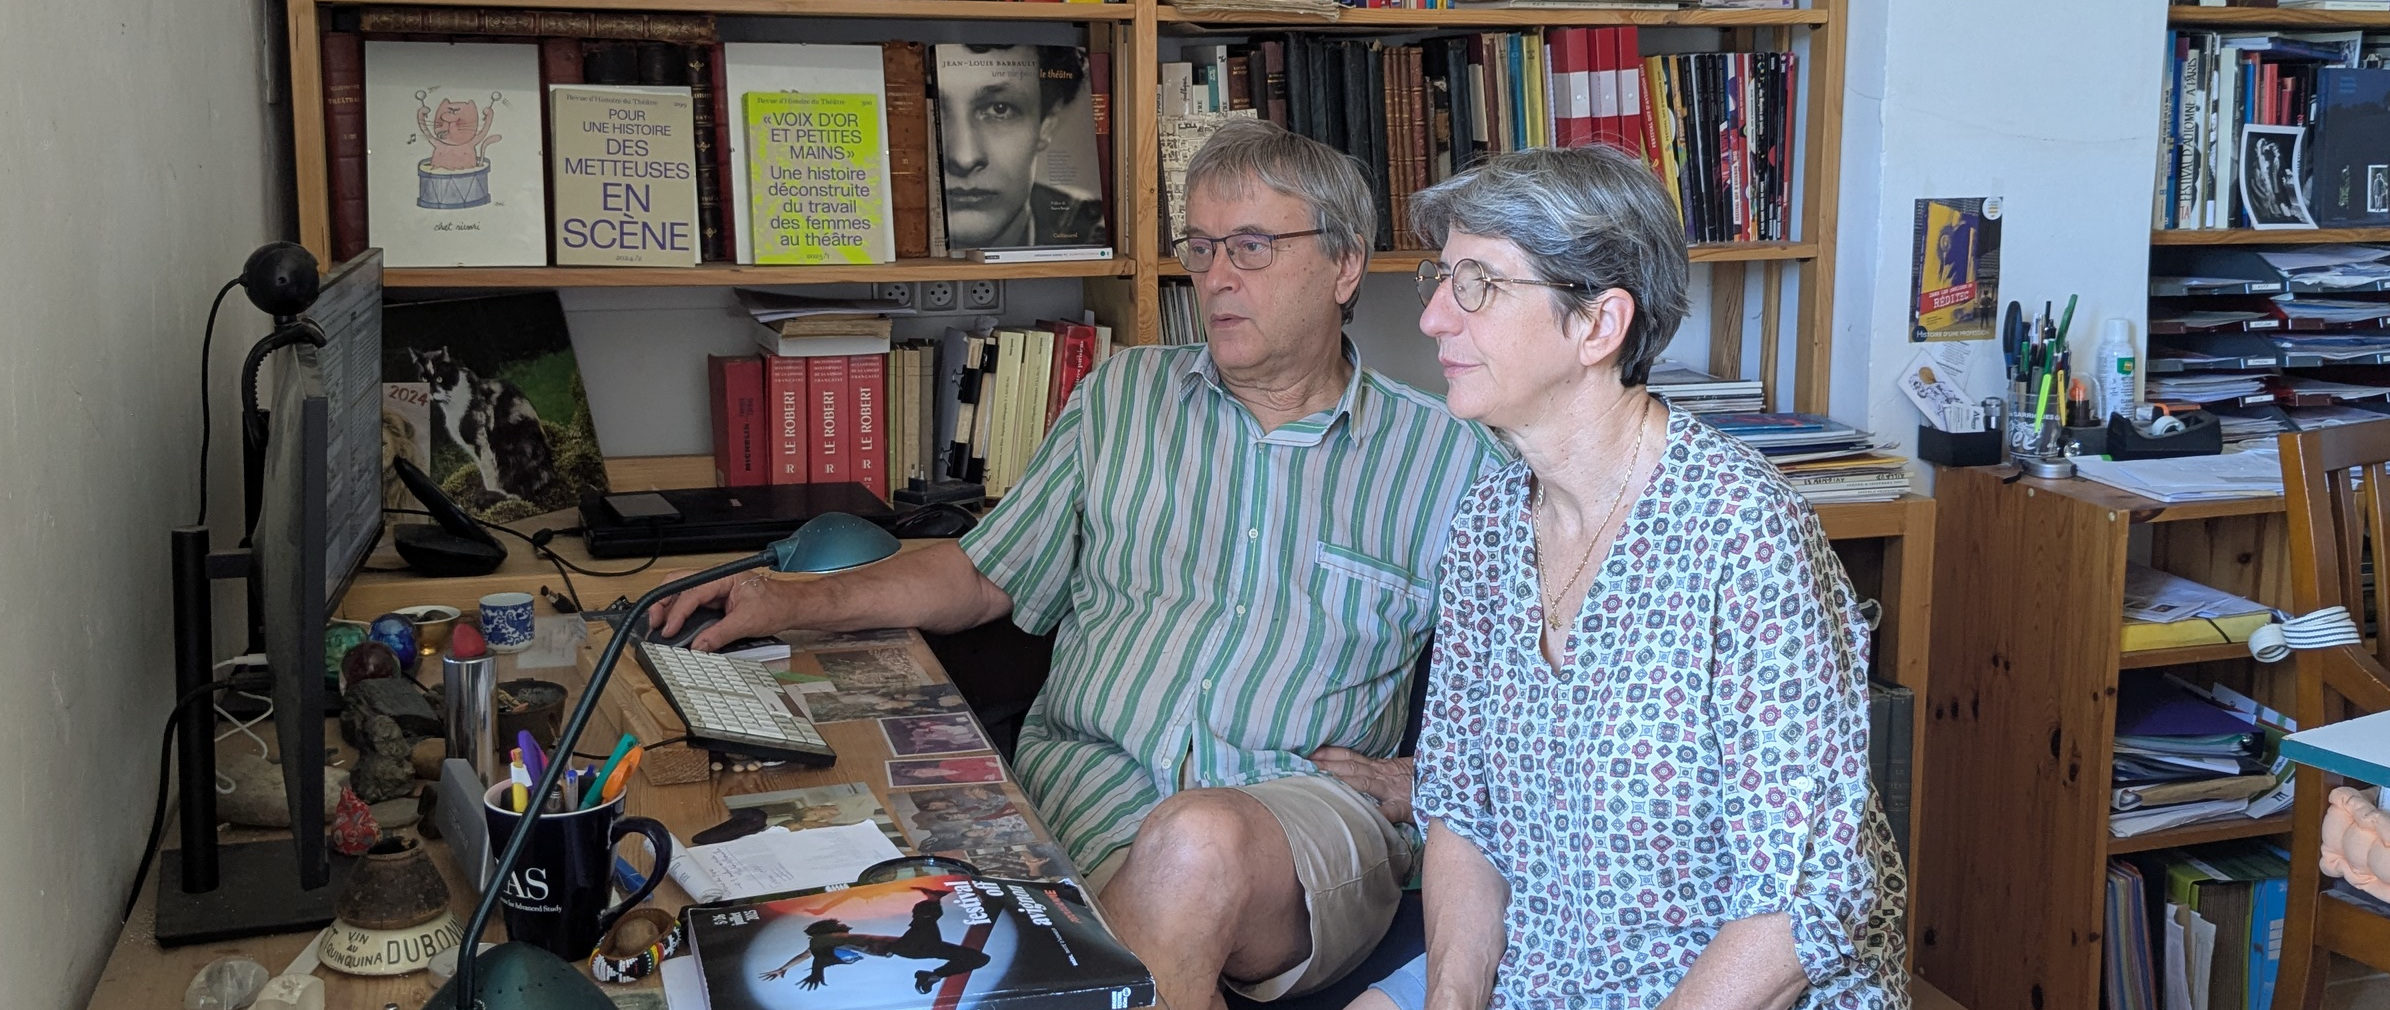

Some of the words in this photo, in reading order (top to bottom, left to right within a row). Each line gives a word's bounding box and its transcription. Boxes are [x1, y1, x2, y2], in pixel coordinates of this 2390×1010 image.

[942, 60, 993, 68] JEAN-LOUIS
[2184, 57, 2197, 86] PARIS
[1040, 68, 1046, 78] le
[608, 108, 646, 121] POUR
[819, 112, 859, 128] D'OR
[1646, 111, 1654, 122] OFF
[583, 121, 610, 134] UNE
[612, 123, 672, 136] HISTOIRE
[771, 128, 791, 143] ET
[796, 129, 863, 144] PETITES
[1648, 122, 1657, 149] FESTIVAL
[2180, 102, 2196, 158] D'AUTOMNE
[606, 138, 650, 157] DES
[565, 157, 690, 179] METTEUSES
[770, 165, 802, 180] Une
[807, 166, 866, 181] histoire
[2179, 160, 2194, 202] FESTIVAL
[602, 182, 650, 213] EN
[768, 182, 870, 198] déconstruite
[783, 199, 803, 213] du
[808, 199, 857, 213] travail
[770, 215, 800, 230] des
[806, 216, 871, 230] femmes
[563, 212, 690, 251] SCÈNE
[780, 234, 800, 247] au
[805, 232, 863, 247] théâtre
[1075, 340, 1084, 368] parisiens
[389, 384, 429, 407] 2024
[784, 391, 796, 437] ROBERT
[823, 391, 836, 437] ROBERT
[860, 387, 872, 433] ROBERT
[785, 440, 796, 455] LE
[824, 440, 836, 455] LE
[861, 436, 873, 451] LE
[786, 463, 795, 474] R
[826, 463, 834, 474] R
[863, 459, 872, 469] R
[972, 880, 1005, 897] off
[515, 902, 543, 912] Advanced
[543, 905, 563, 913] Study
[943, 880, 992, 925] festival
[1007, 884, 1053, 926] avignon
[348, 931, 370, 945] VIN
[326, 942, 383, 969] QUINQUINA
[346, 944, 359, 953] AU
